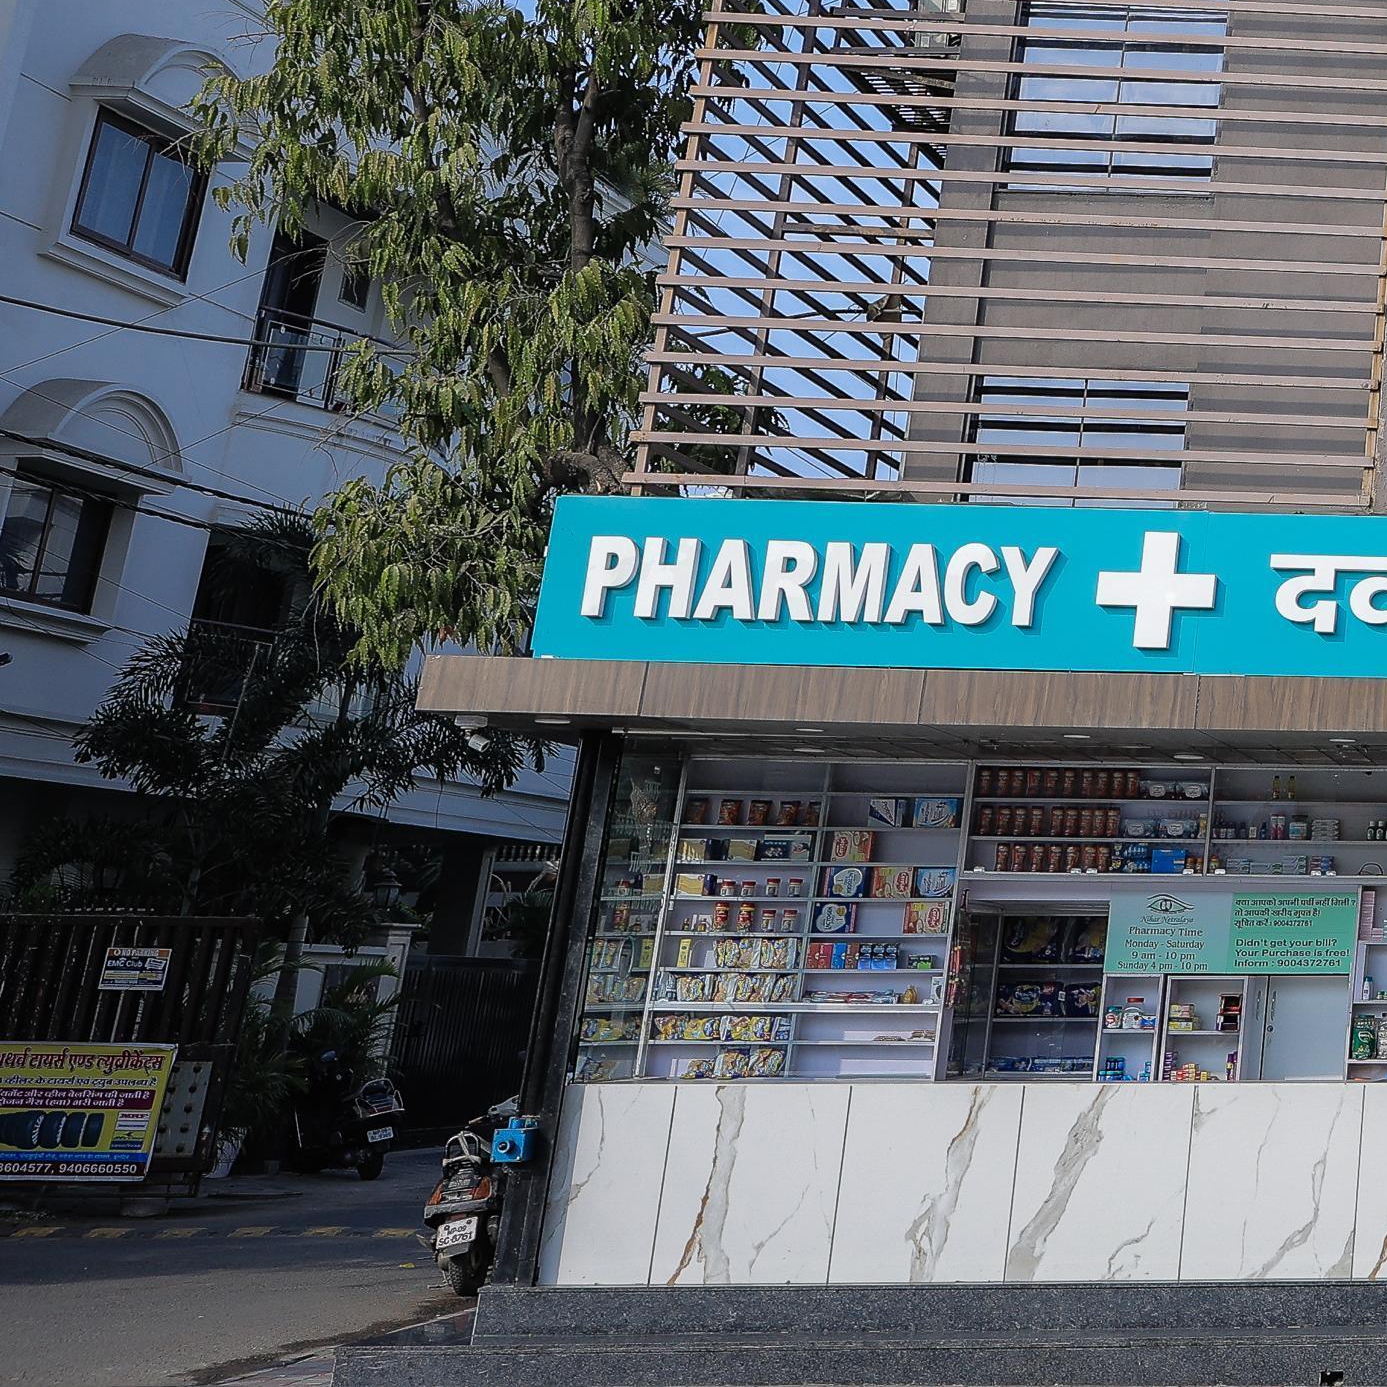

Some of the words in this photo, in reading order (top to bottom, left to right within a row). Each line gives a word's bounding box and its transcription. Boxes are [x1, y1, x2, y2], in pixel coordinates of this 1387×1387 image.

[580, 535, 1058, 627] PHARMACY
[1250, 898, 1276, 906] आपको
[1278, 898, 1300, 906] अपनी
[1235, 908, 1243, 916] तो
[1244, 908, 1269, 916] आपकी
[1271, 908, 1292, 916] खरीद
[1129, 926, 1175, 937] Pharmacy
[1178, 928, 1203, 937] Time
[1125, 939, 1159, 949] Monday
[1166, 939, 1204, 950] Saturday
[1236, 939, 1268, 947] Didn't
[1270, 939, 1287, 948] get
[1289, 940, 1314, 948] your
[1316, 939, 1337, 947] bill?
[1132, 951, 1138, 960] 9
[1165, 951, 1177, 960] 10
[1180, 953, 1195, 961] pm
[1235, 949, 1260, 957] Your
[1261, 949, 1311, 957] Purchase
[1313, 949, 1322, 957] is
[1325, 949, 1350, 957] free!
[1118, 961, 1149, 971] Sunday
[1150, 961, 1156, 969] 4
[1159, 963, 1173, 971] pm
[1181, 962, 1191, 970] 10
[1194, 963, 1208, 972] pm
[1234, 959, 1268, 967] Inform
[1277, 959, 1341, 967] 9004372761
[30, 1047, 69, 1069] टायर्स
[59, 1163, 137, 1174] 9406660550
